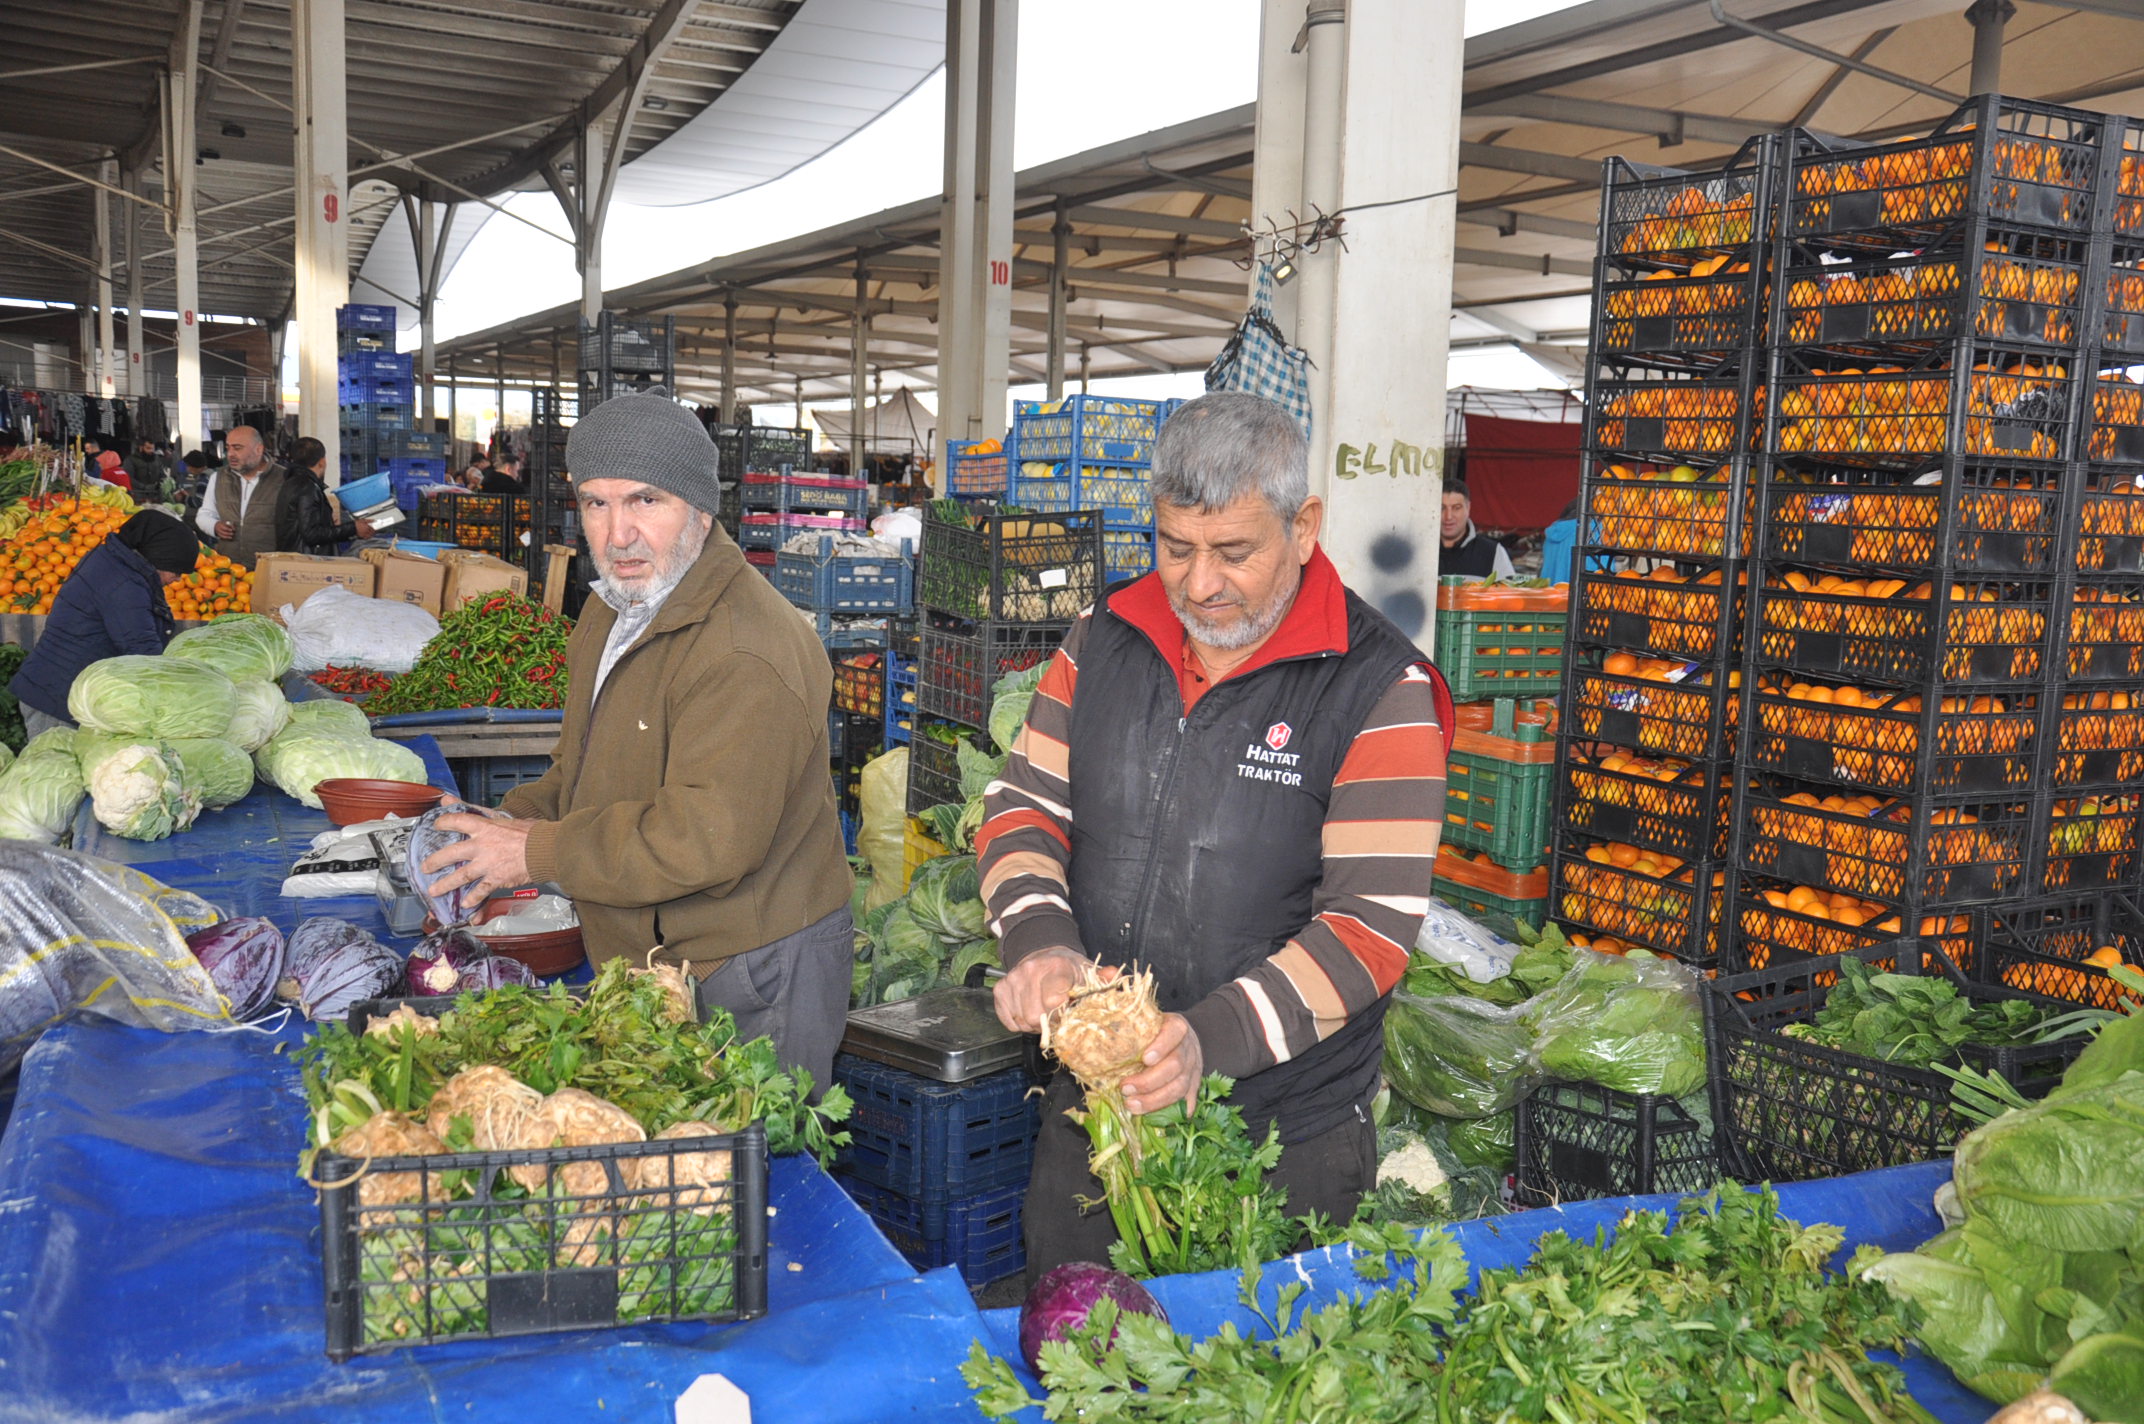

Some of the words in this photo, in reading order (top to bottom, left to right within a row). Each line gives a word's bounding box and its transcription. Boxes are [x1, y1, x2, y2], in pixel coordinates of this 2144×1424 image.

[323, 193, 338, 224] 9
[990, 260, 1009, 286] 10
[184, 309, 194, 326] 9
[132, 352, 140, 364] 9
[1246, 744, 1300, 767] HATTAT
[1237, 764, 1302, 787] TRAKTÖR
